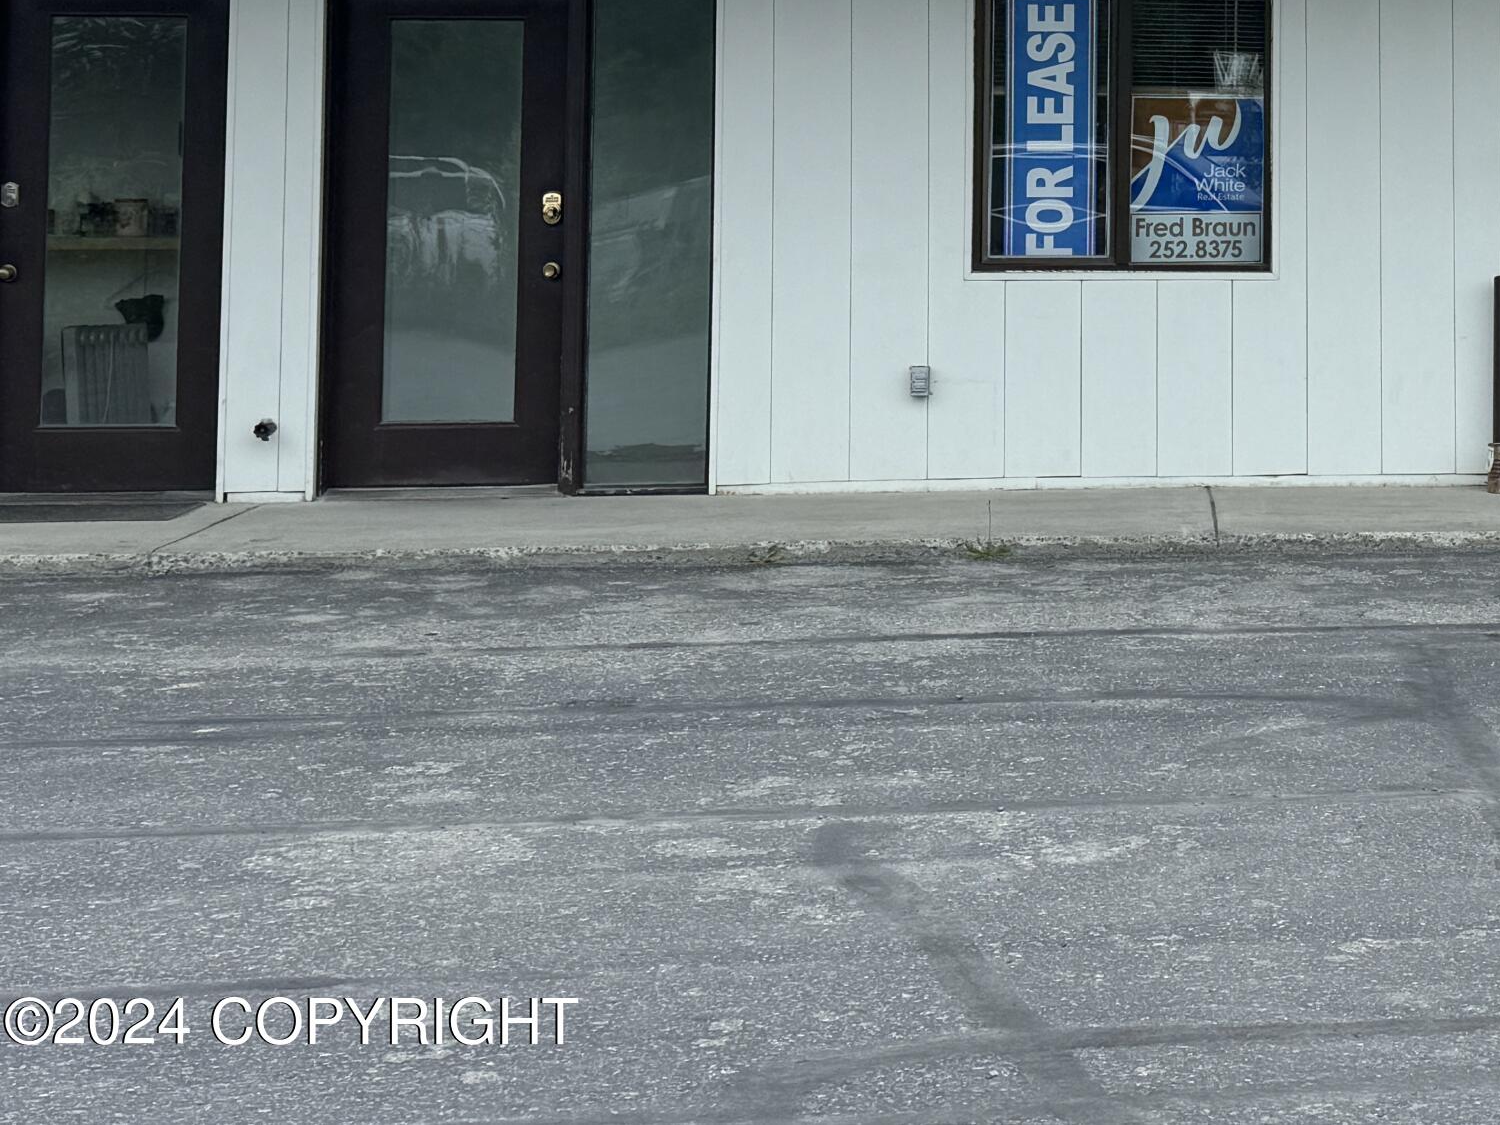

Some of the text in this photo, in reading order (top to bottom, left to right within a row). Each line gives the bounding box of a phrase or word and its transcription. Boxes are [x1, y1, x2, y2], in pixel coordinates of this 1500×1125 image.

[1025, 3, 1076, 256] FOR LEASE
[1204, 163, 1246, 178] Jack
[1195, 179, 1246, 193] White
[1197, 193, 1245, 202] Real Estate
[1135, 217, 1256, 238] Fred Braun
[1149, 240, 1243, 259] 252.8375
